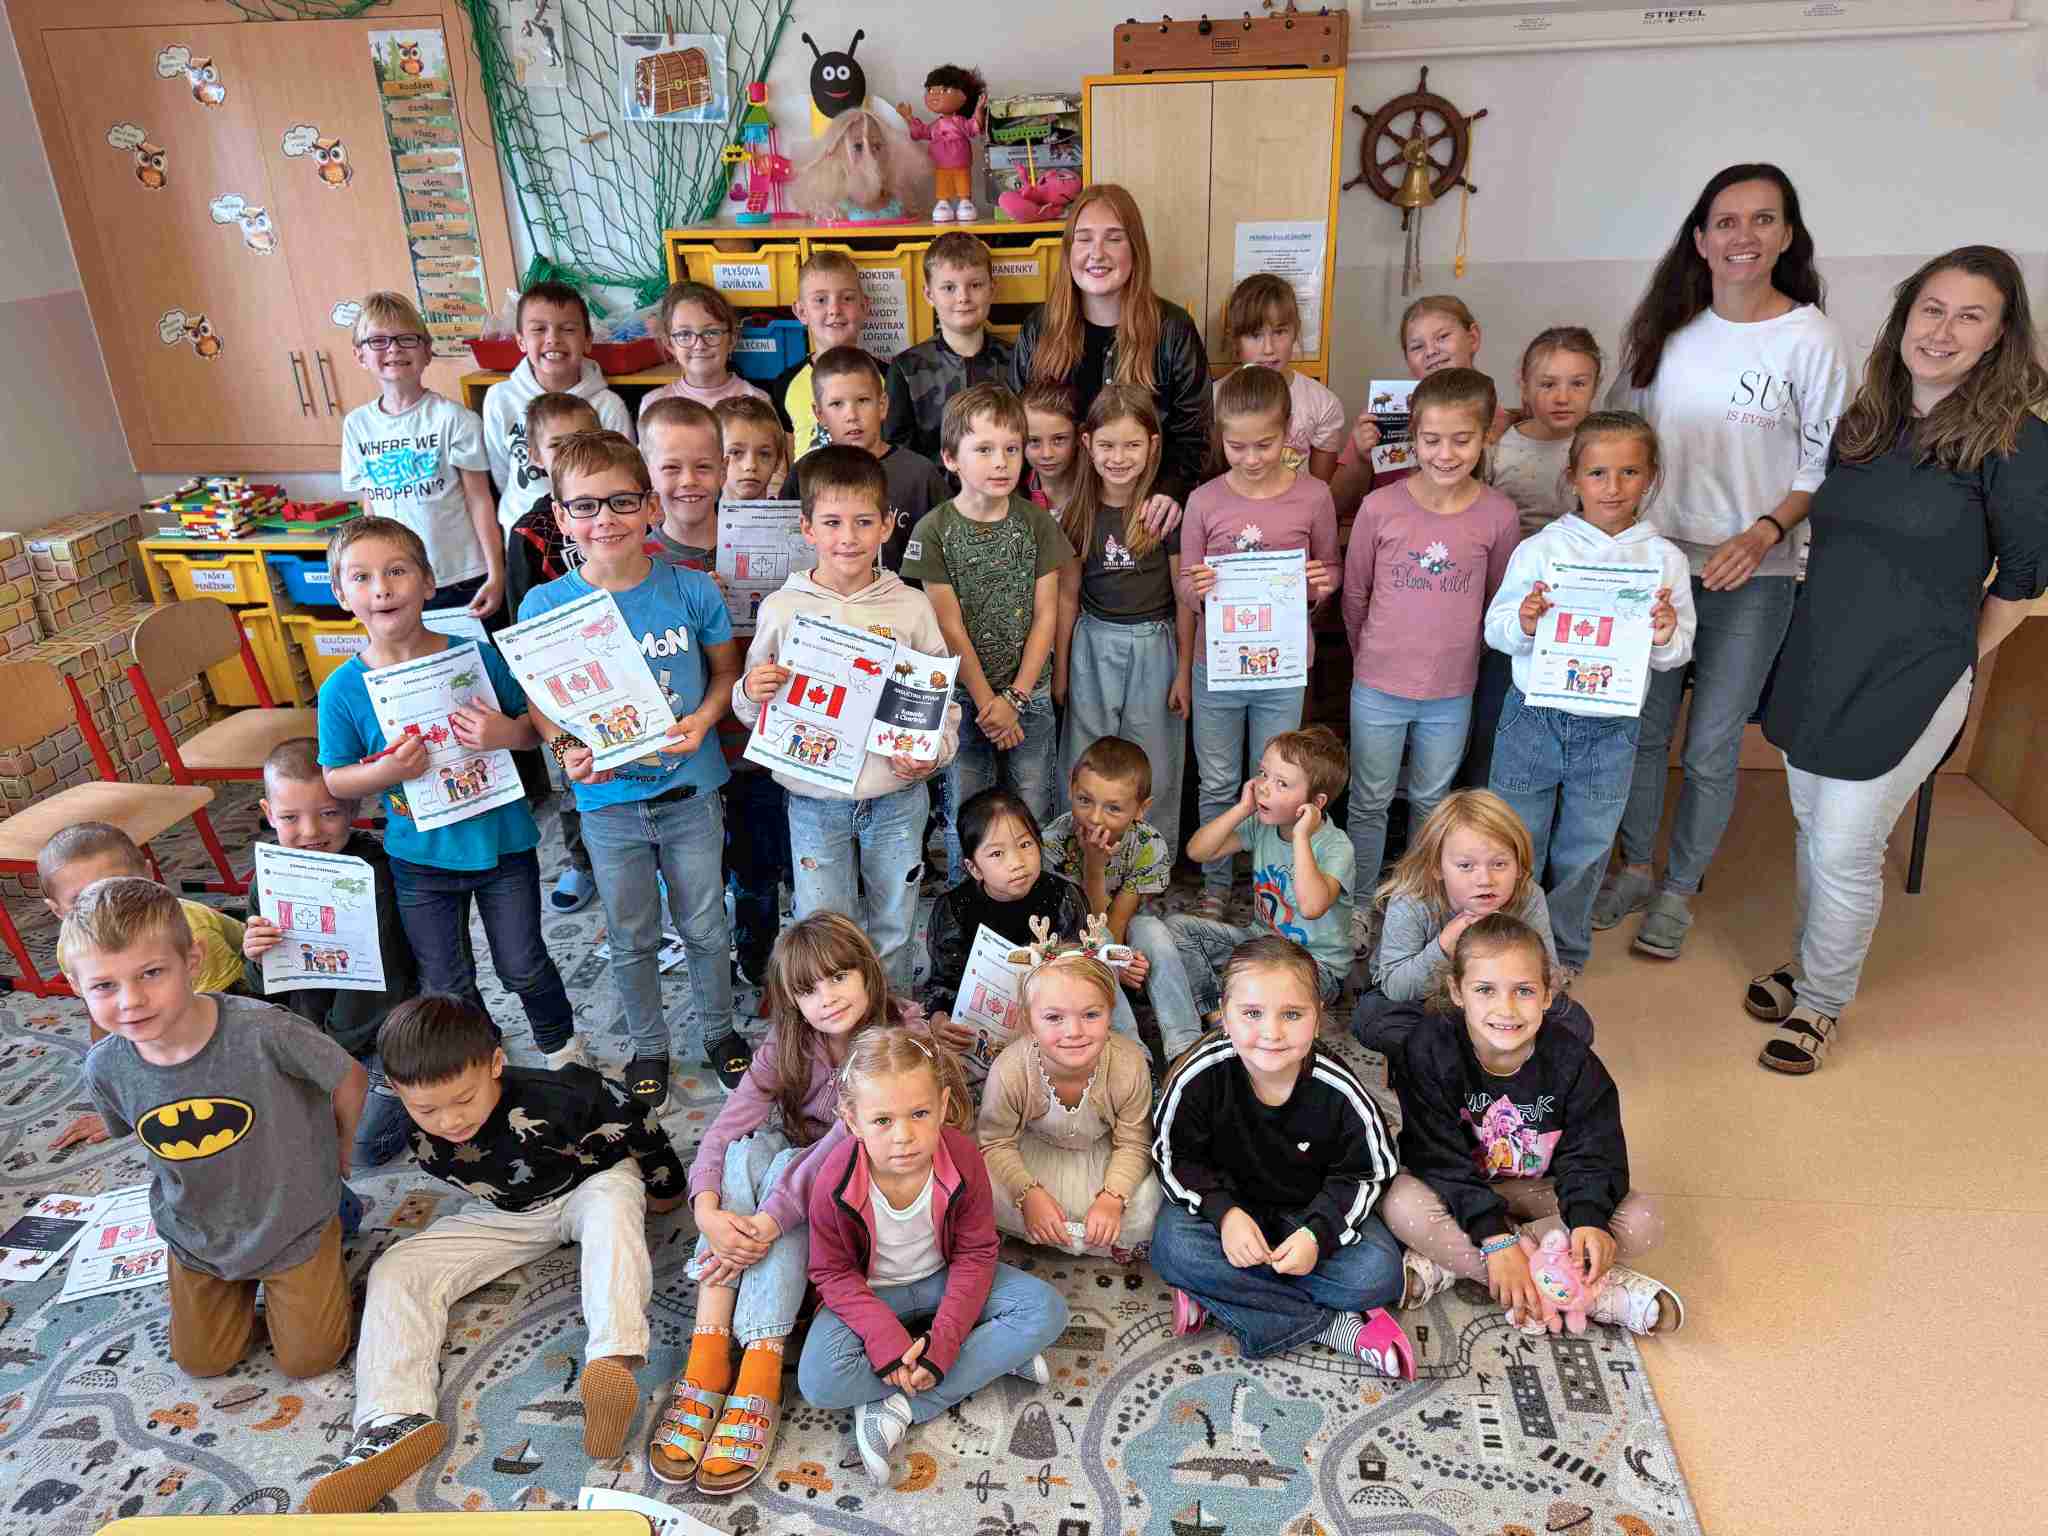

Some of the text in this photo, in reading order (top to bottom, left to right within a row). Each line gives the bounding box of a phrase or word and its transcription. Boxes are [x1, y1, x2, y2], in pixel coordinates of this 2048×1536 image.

[1643, 9, 1707, 19] STIEFEL
[858, 271, 895, 280] DOKTOR
[863, 320, 905, 330] RAVITRAX
[358, 433, 439, 457] WHERE WE
